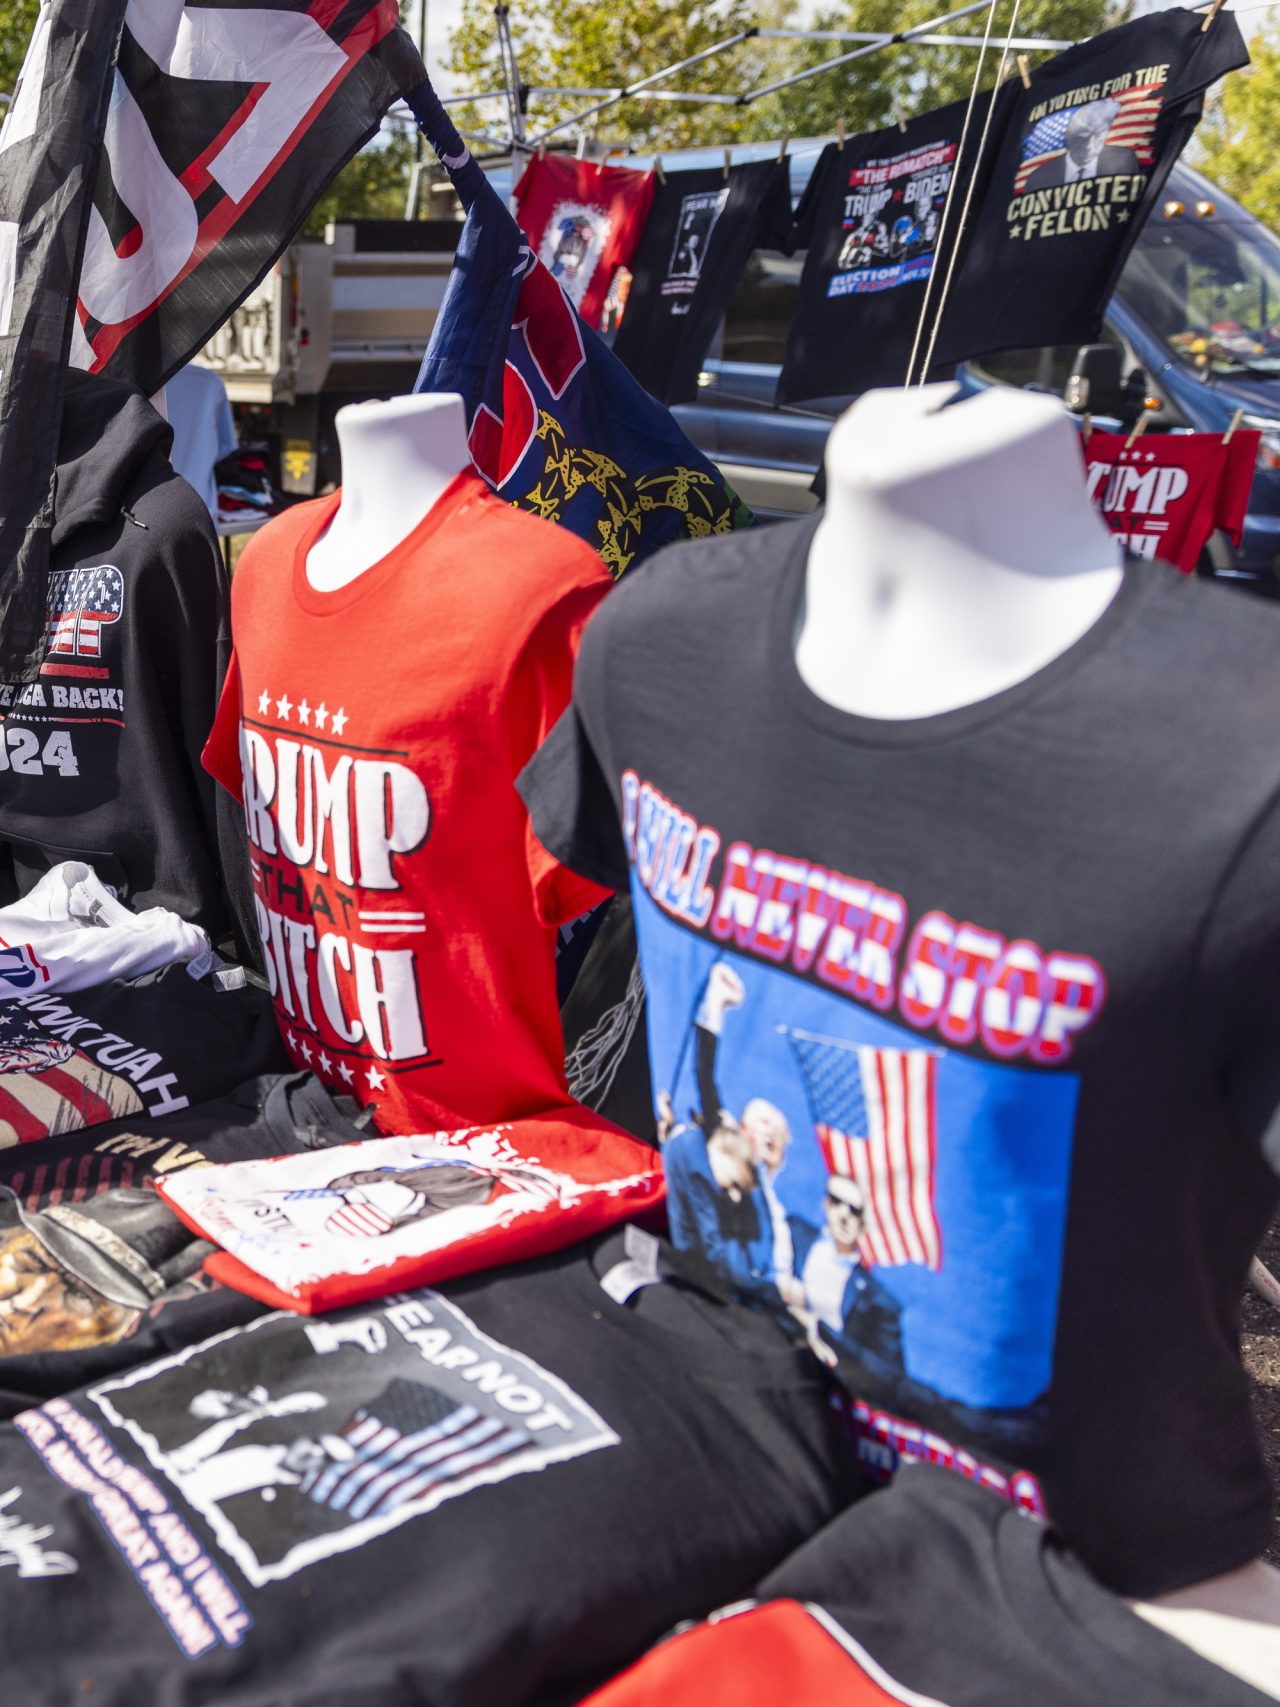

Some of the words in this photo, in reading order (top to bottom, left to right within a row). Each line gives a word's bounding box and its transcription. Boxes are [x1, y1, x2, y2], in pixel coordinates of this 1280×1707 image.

[1049, 84, 1101, 113] VOTING
[1102, 73, 1132, 98] FOR
[1135, 64, 1170, 86] THE
[844, 188, 893, 217] TRUMP
[903, 171, 952, 204] BIDEN
[1024, 204, 1112, 241] FELON
[51, 685, 125, 712] BACK!
[239, 728, 432, 892] RUMP
[260, 863, 354, 931] THAT
[636, 780, 721, 929] WILL
[710, 841, 908, 1010] NEVER
[899, 910, 1107, 1065] STOP
[18, 993, 103, 1042] AWK
[80, 1032, 190, 1118] TUAH
[461, 1359, 575, 1432] NOT
[148, 1513, 201, 1567] AND
[183, 1555, 211, 1582] I
[194, 1568, 250, 1645] WILL
